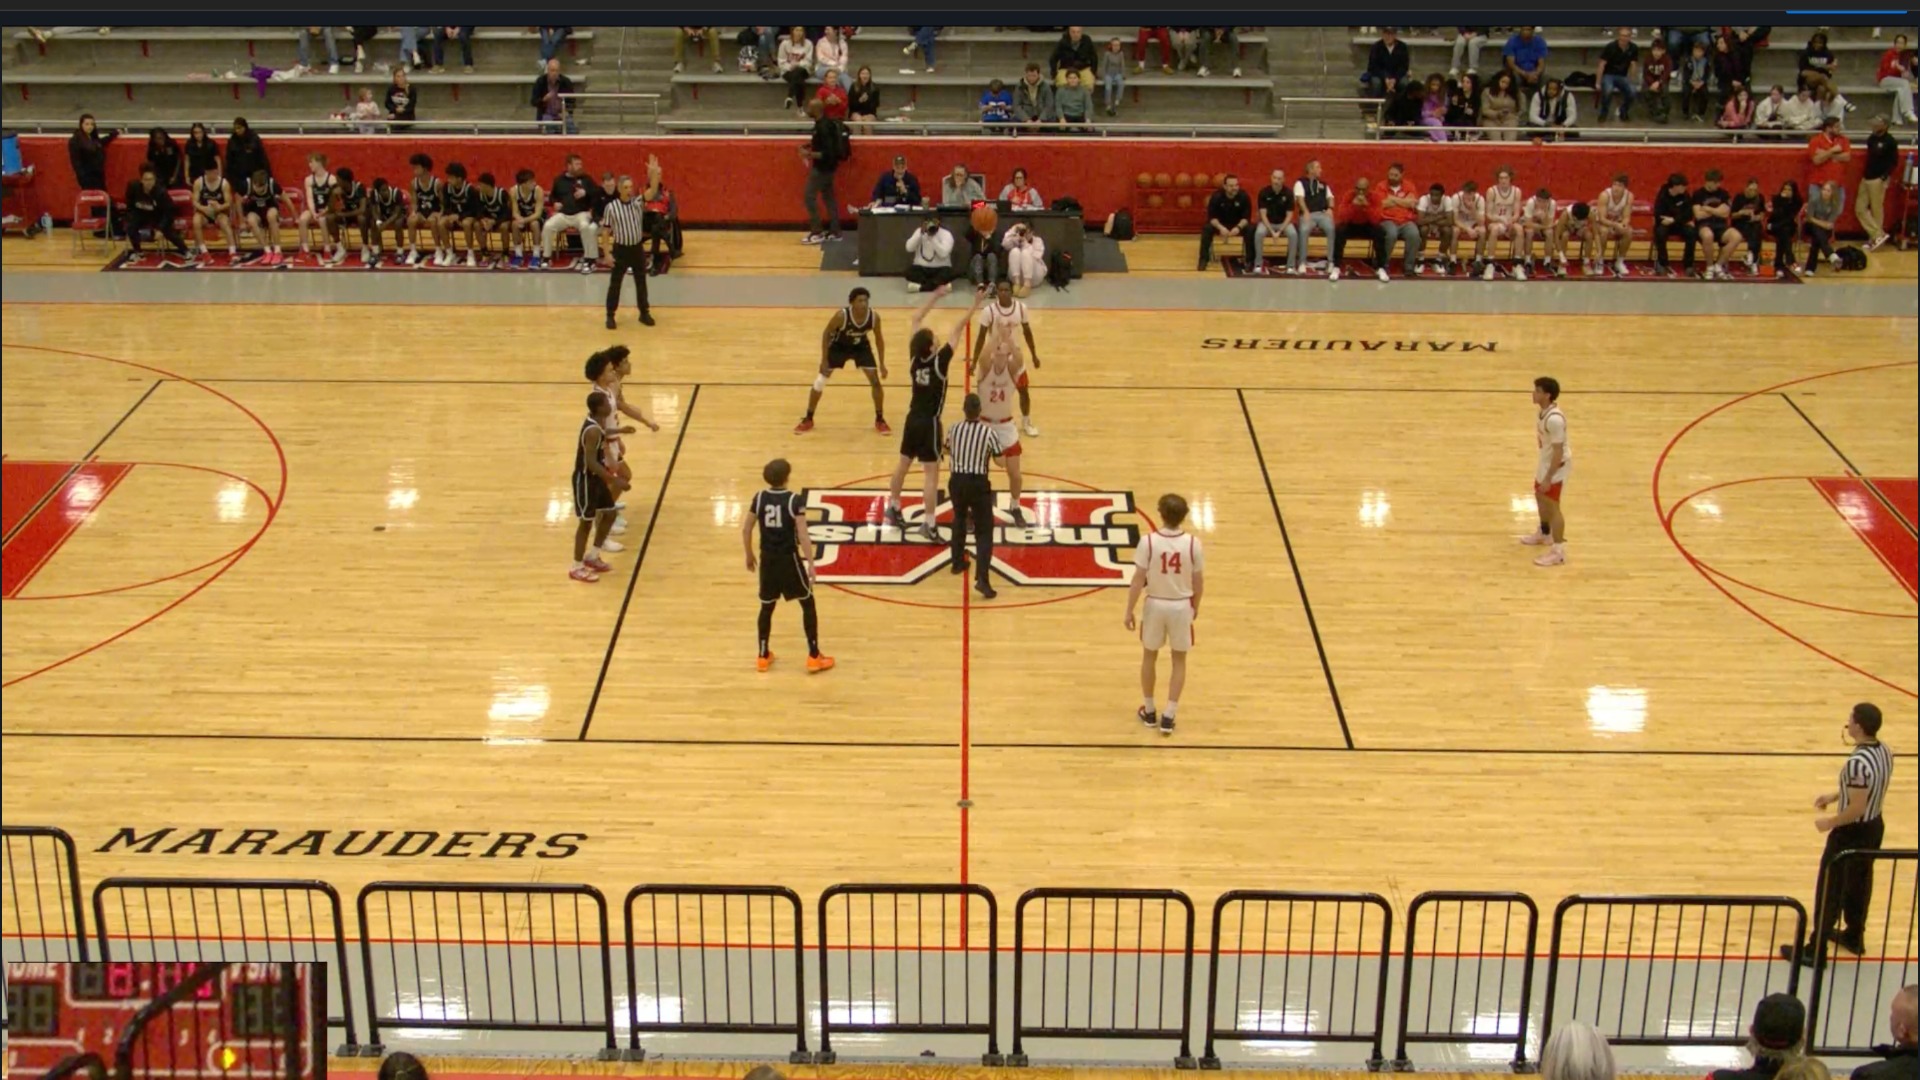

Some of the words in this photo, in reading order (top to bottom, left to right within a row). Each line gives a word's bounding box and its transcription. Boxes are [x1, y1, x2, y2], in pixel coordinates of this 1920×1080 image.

[1201, 338, 1498, 352] MARAUDERS
[989, 389, 1005, 403] 24
[764, 504, 782, 528] 21
[1160, 552, 1182, 575] 14
[94, 827, 588, 859] MARAUDERS
